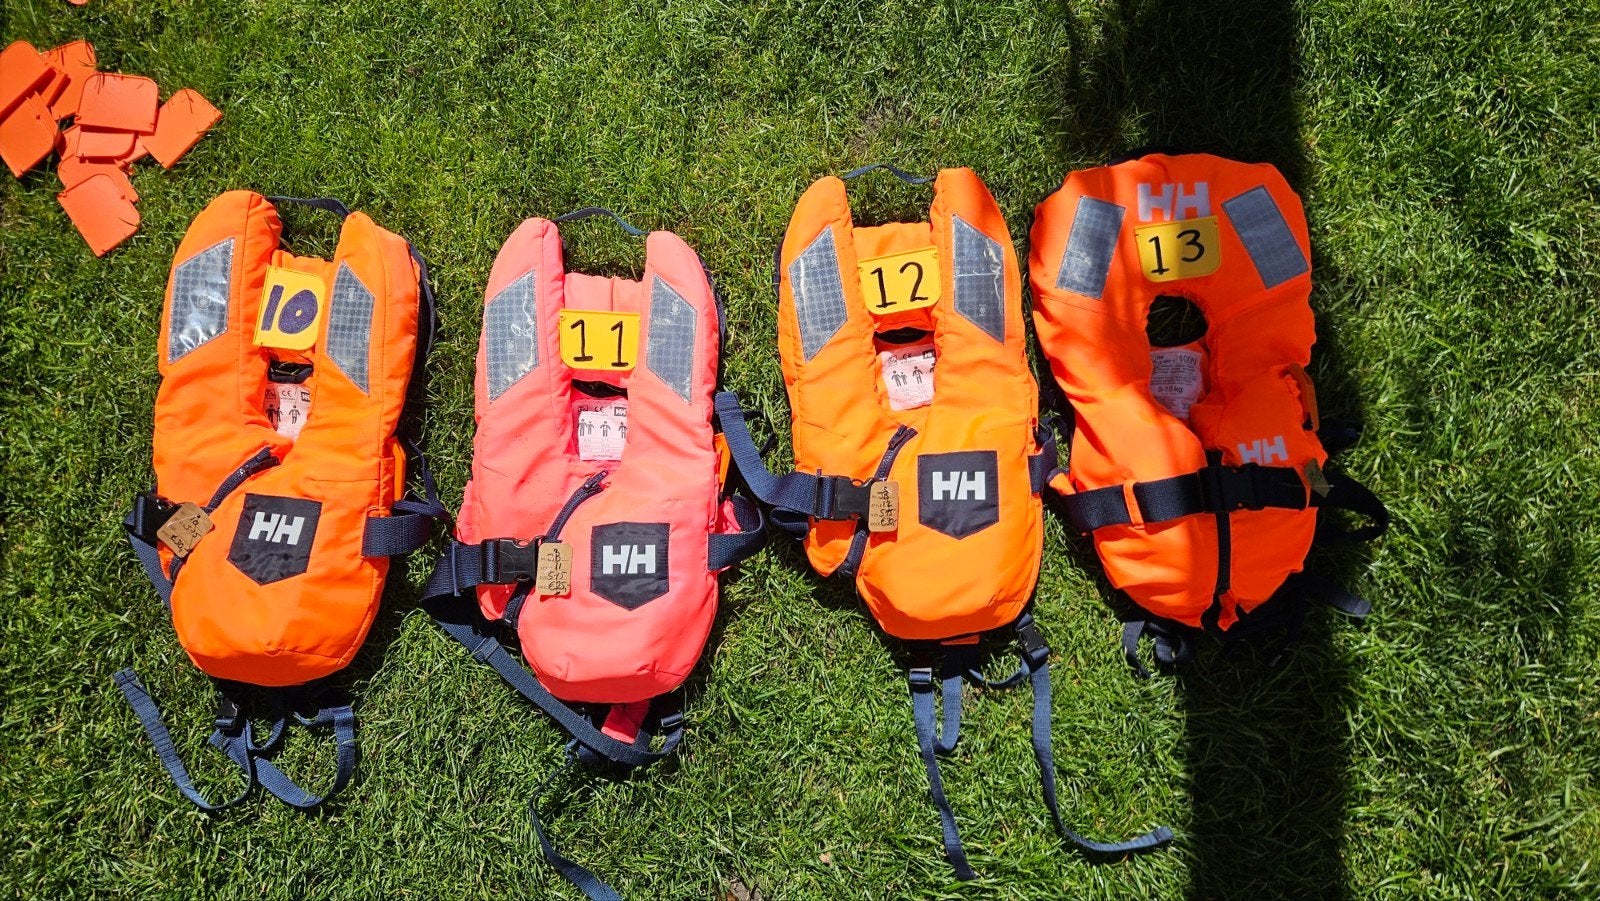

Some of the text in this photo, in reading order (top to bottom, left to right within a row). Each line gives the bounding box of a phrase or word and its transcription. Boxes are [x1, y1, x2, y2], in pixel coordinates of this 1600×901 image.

[1137, 181, 1211, 222] HH
[1148, 229, 1205, 275] 13
[870, 261, 929, 308] 12
[261, 285, 318, 334] 10
[570, 319, 629, 367] 11
[1179, 355, 1197, 366] 100N
[282, 390, 293, 398] CE
[1173, 385, 1184, 394] kg
[1237, 435, 1289, 464] HH
[932, 471, 986, 500] HH
[248, 511, 305, 545] HH
[602, 545, 656, 574] HH
